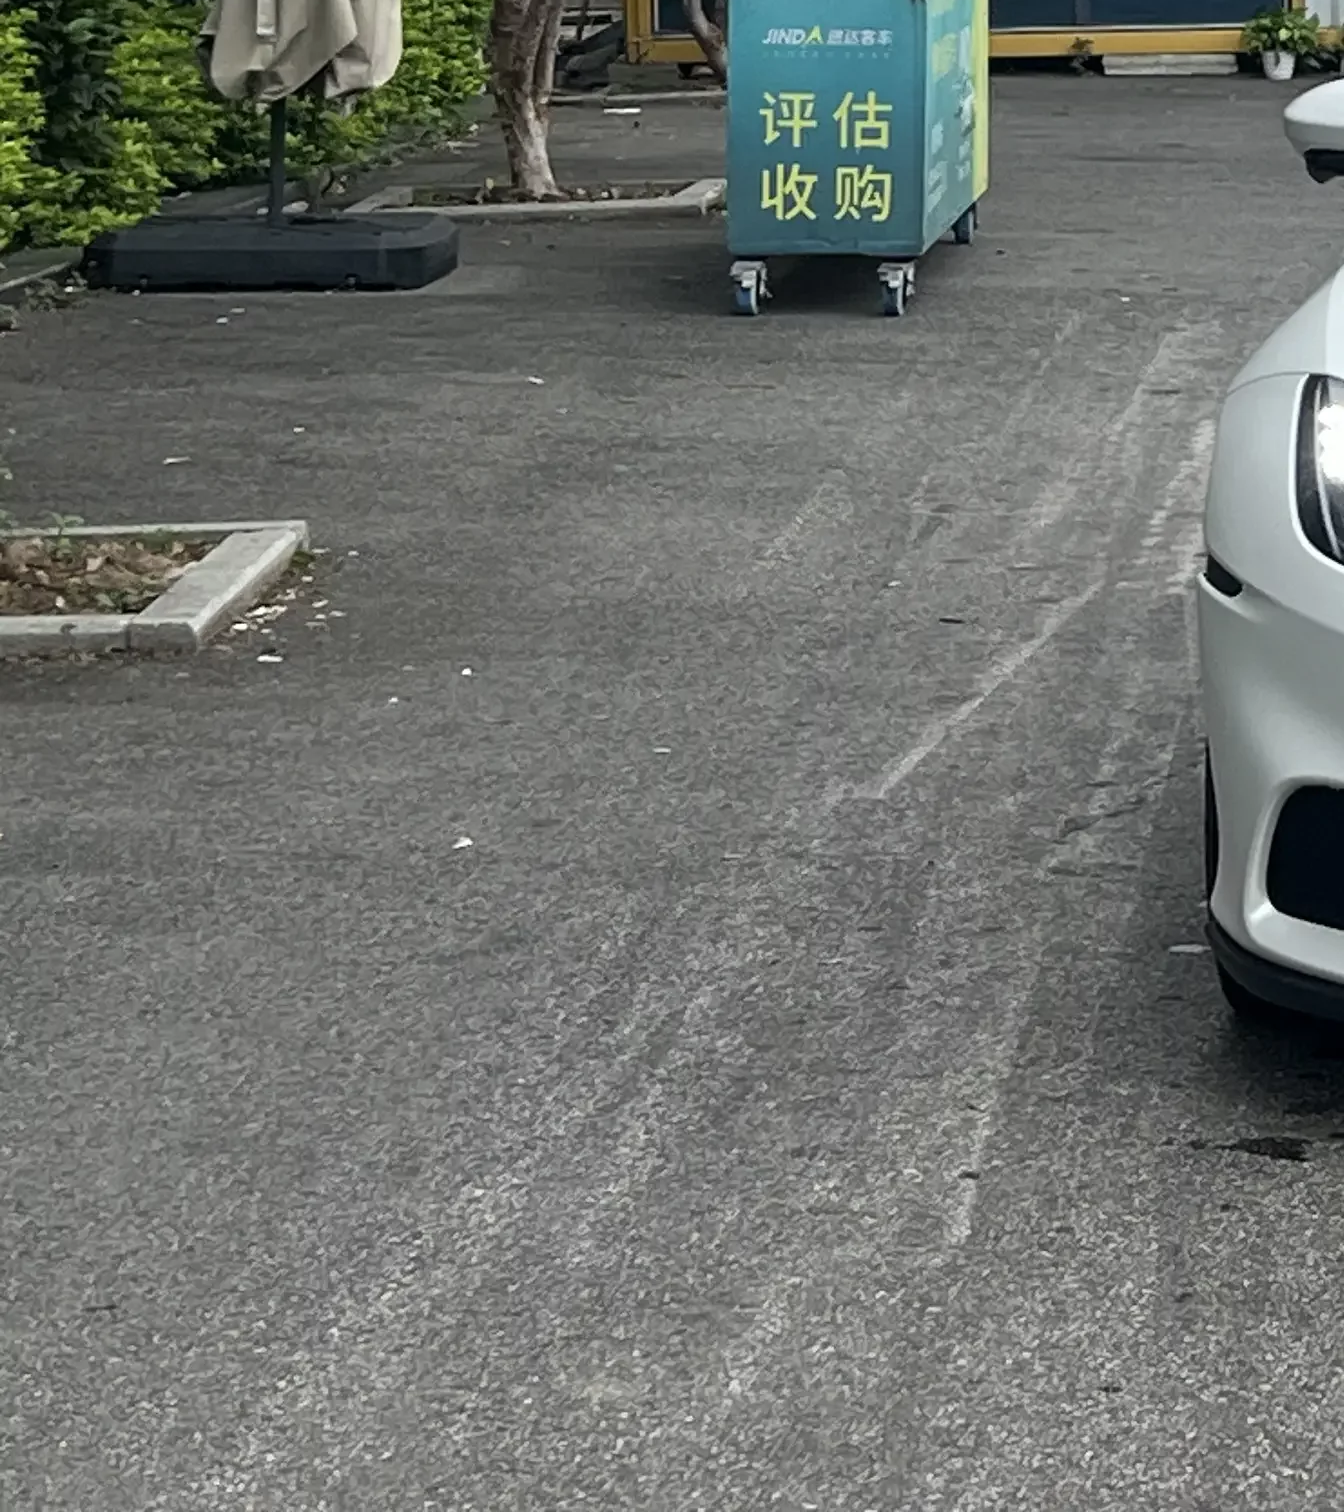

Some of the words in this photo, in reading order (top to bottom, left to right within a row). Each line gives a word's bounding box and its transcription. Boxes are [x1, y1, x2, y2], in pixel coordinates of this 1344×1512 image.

[762, 25, 824, 45] JINDA
[758, 91, 893, 148] 评估
[760, 163, 893, 222] 收购
